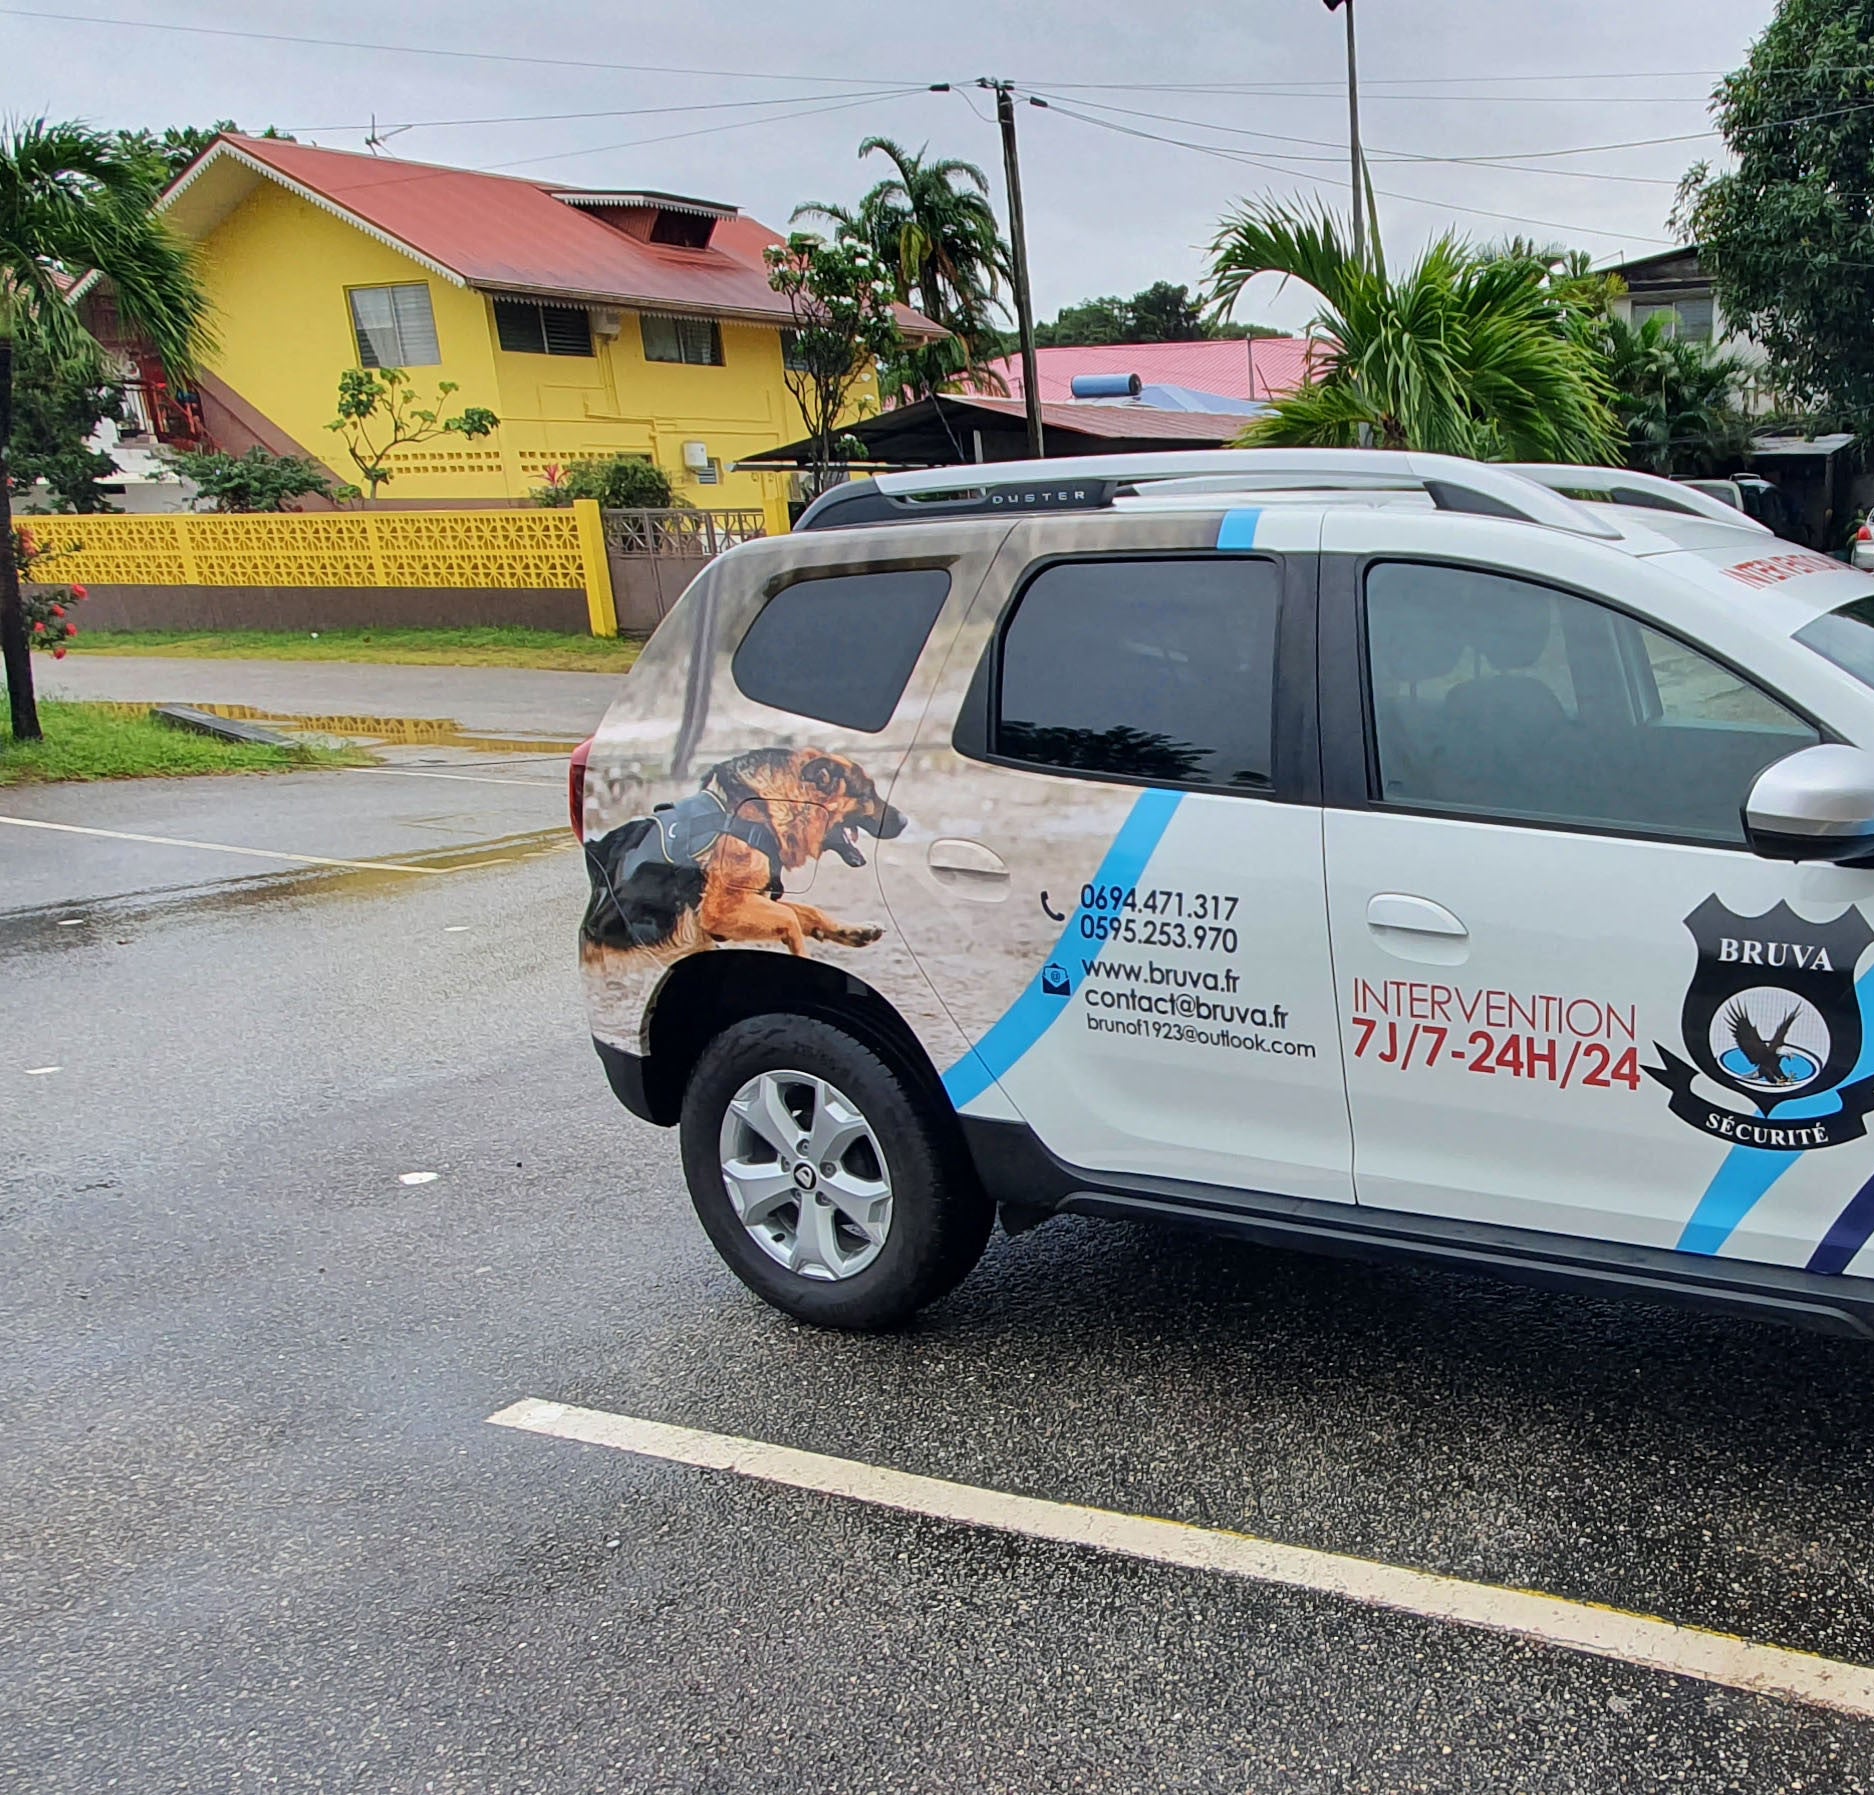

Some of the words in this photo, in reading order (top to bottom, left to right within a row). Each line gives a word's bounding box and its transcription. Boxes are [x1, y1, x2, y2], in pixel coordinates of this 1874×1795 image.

[992, 490, 1085, 504] DUSTER
[1080, 883, 1240, 921] 0694.471.317
[1080, 914, 1239, 953] 0595.253.970
[1717, 937, 1835, 973] BRUVA
[1081, 958, 1241, 993] www.bruva.fr
[1084, 987, 1289, 1030] contact@bruva.fr
[1353, 977, 1637, 1042] INTERVENTION
[1086, 1012, 1317, 1058] brunof1923@outlook.com
[1351, 1016, 1641, 1092] 7J/7-24H/24
[1705, 1112, 1830, 1147] SÉCURITÉ
